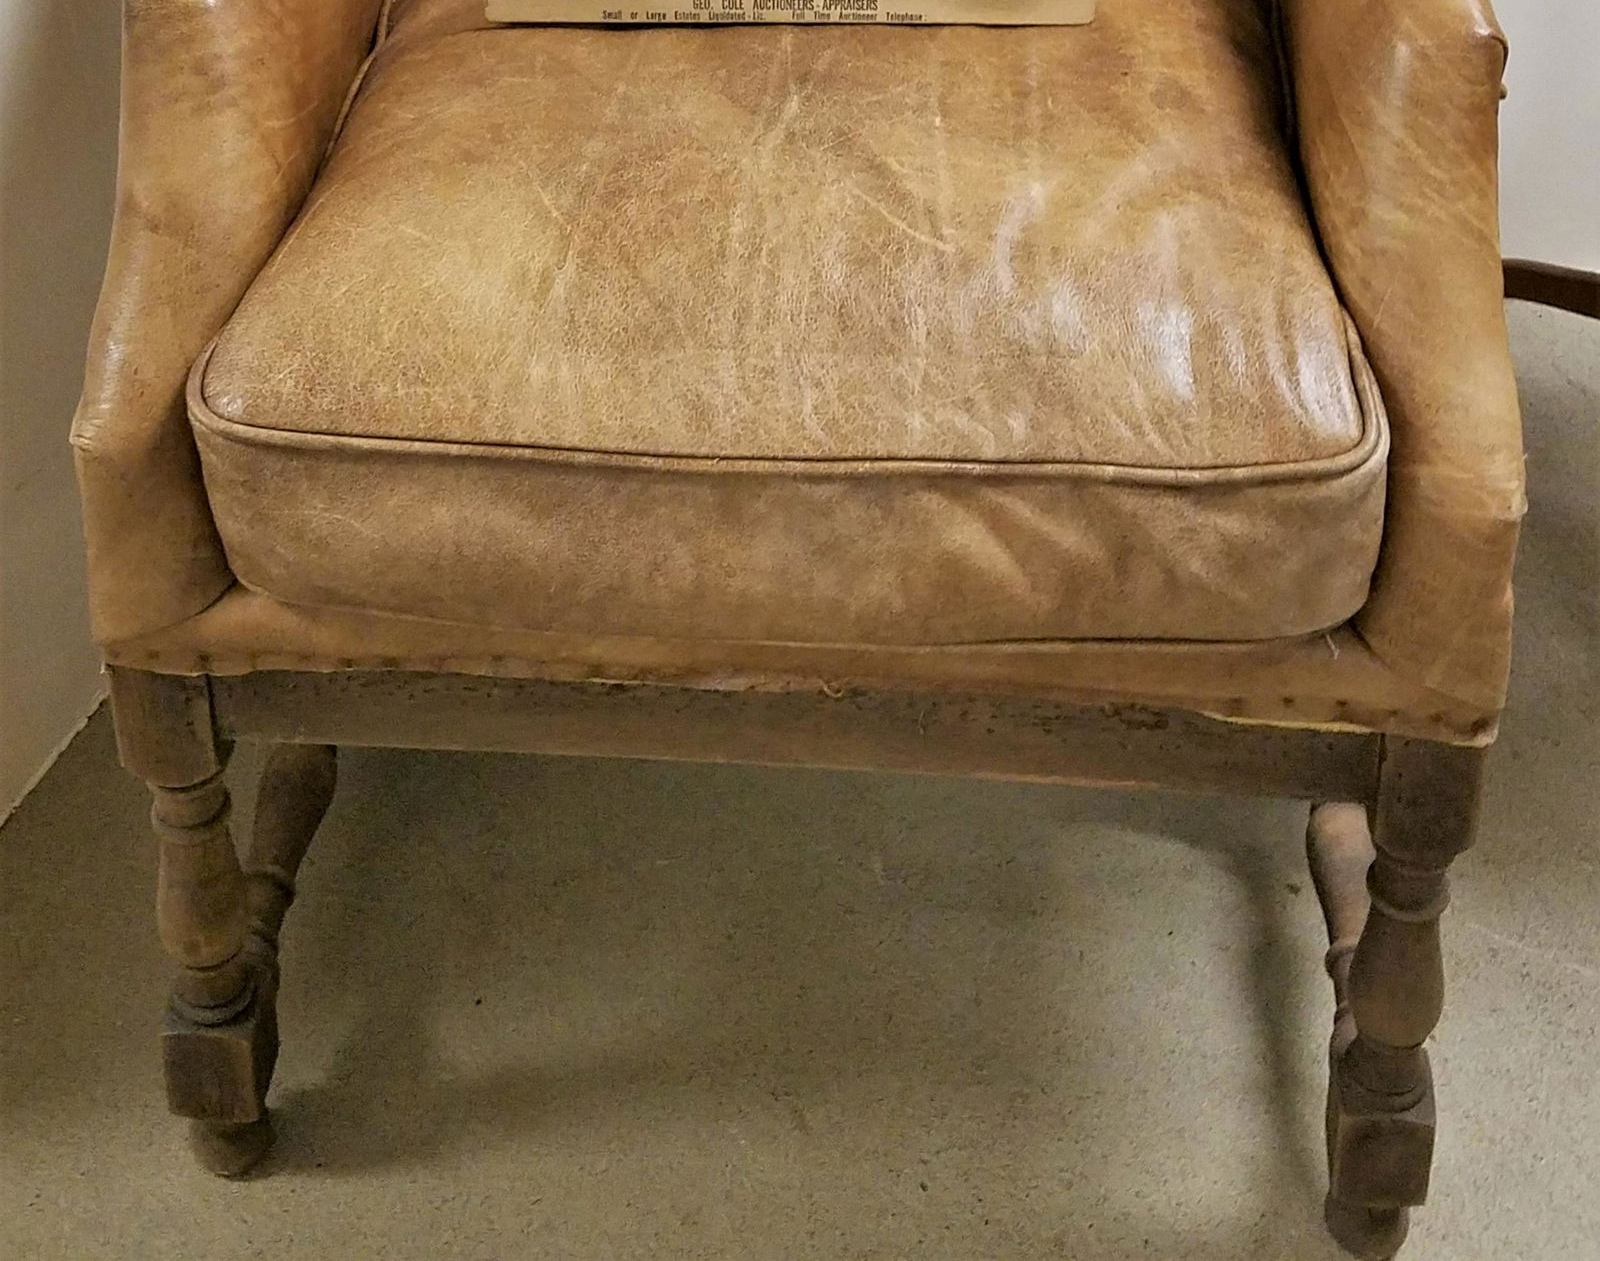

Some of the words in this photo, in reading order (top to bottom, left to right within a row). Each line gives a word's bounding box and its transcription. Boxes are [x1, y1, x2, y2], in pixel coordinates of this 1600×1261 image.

[602, 10, 622, 20] Small
[630, 12, 638, 20] or
[646, 11, 666, 22] Large
[674, 11, 700, 21] Estates
[814, 11, 831, 21] Time
